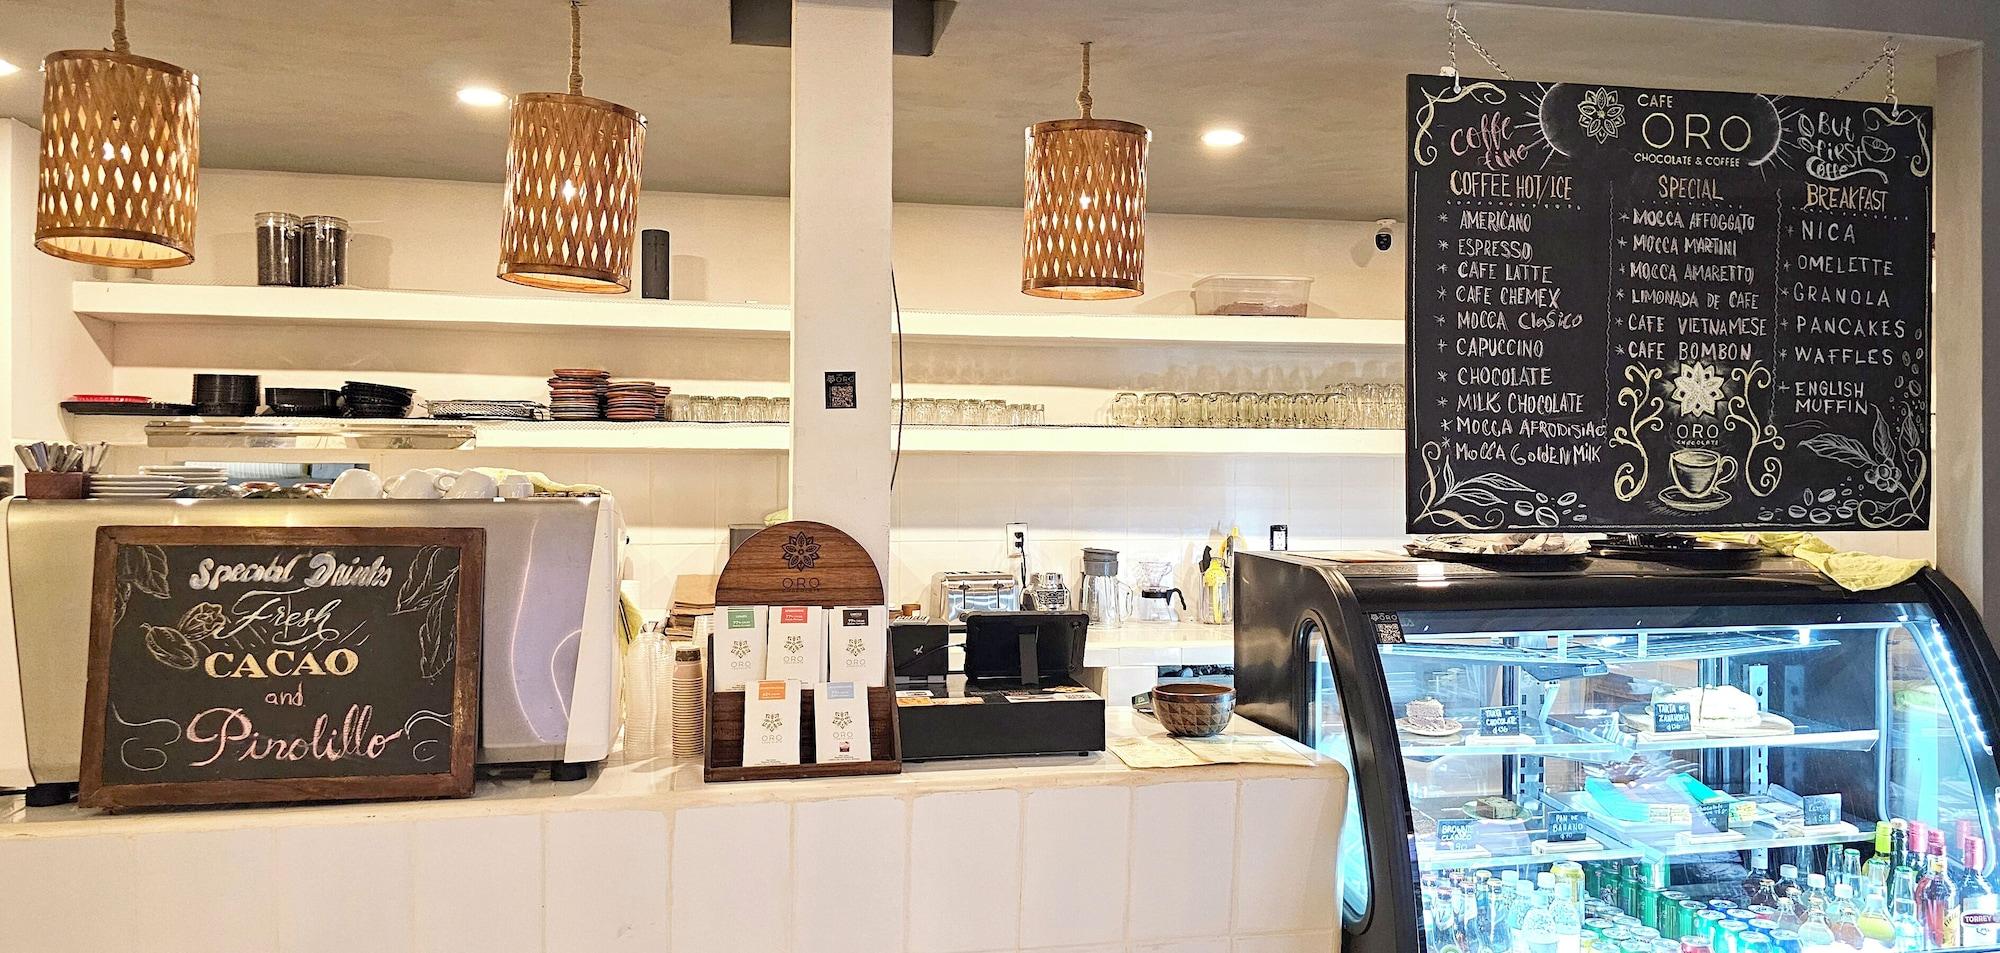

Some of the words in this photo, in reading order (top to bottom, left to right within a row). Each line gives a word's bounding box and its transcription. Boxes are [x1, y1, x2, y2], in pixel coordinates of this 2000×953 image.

[1637, 94, 1673, 108] CAFE
[1642, 112, 1751, 152] ORO
[1634, 153, 1692, 166] CHOCOLATE
[1695, 157, 1702, 166] &
[1705, 157, 1740, 167] COFFEE
[1450, 170, 1511, 198] COFFEE
[1516, 174, 1573, 204] HOT/ICE
[1658, 174, 1724, 200] SPECIAL
[1804, 182, 1888, 212] BREAKFAST
[1459, 210, 1532, 232] AMERICANO
[1632, 208, 1684, 228] MOCCA
[1689, 213, 1755, 235] AFFOGGATO
[1802, 220, 1855, 244] NICA
[1458, 238, 1533, 262] ESPRESSO
[1633, 234, 1678, 255] MOCCA
[1684, 236, 1737, 257] MARTINI
[1457, 262, 1497, 280] CAFE
[1505, 263, 1553, 283] LATTE
[1630, 261, 1677, 282] MOCCA
[1684, 264, 1755, 285] AMARETTO
[1798, 254, 1894, 276] OMELETTE
[1456, 285, 1492, 305] CAFE
[1500, 287, 1562, 309] CHEMEX
[1631, 289, 1699, 308] LIMONADA
[1707, 293, 1721, 310] DE
[1729, 291, 1760, 310] CAFE
[1793, 281, 1891, 308] GRANOLA
[1457, 311, 1509, 331] MOCCA
[1628, 313, 1665, 333] CAFE
[1678, 317, 1768, 336] VIETNAMESE
[1797, 316, 1906, 339] PANCAKES
[1456, 337, 1544, 359] CAPUCCINO
[1628, 340, 1665, 360] CAFE
[1679, 341, 1752, 360] BOMBON
[1794, 346, 1894, 366] WAFFLES
[1457, 367, 1553, 387] CHOCOLATE
[1795, 380, 1864, 399] ENGLISH
[1456, 392, 1501, 413] MILK
[1508, 392, 1585, 415] CHOCOLATE
[1795, 398, 1868, 415] MUFFIN
[1456, 416, 1513, 437] MOCCA
[1676, 424, 1719, 439] ORO
[302, 551, 394, 589] Drinks
[782, 577, 820, 589] ORO
[213, 587, 342, 645] Fresh
[204, 647, 360, 679] CACAO
[265, 682, 304, 707] and
